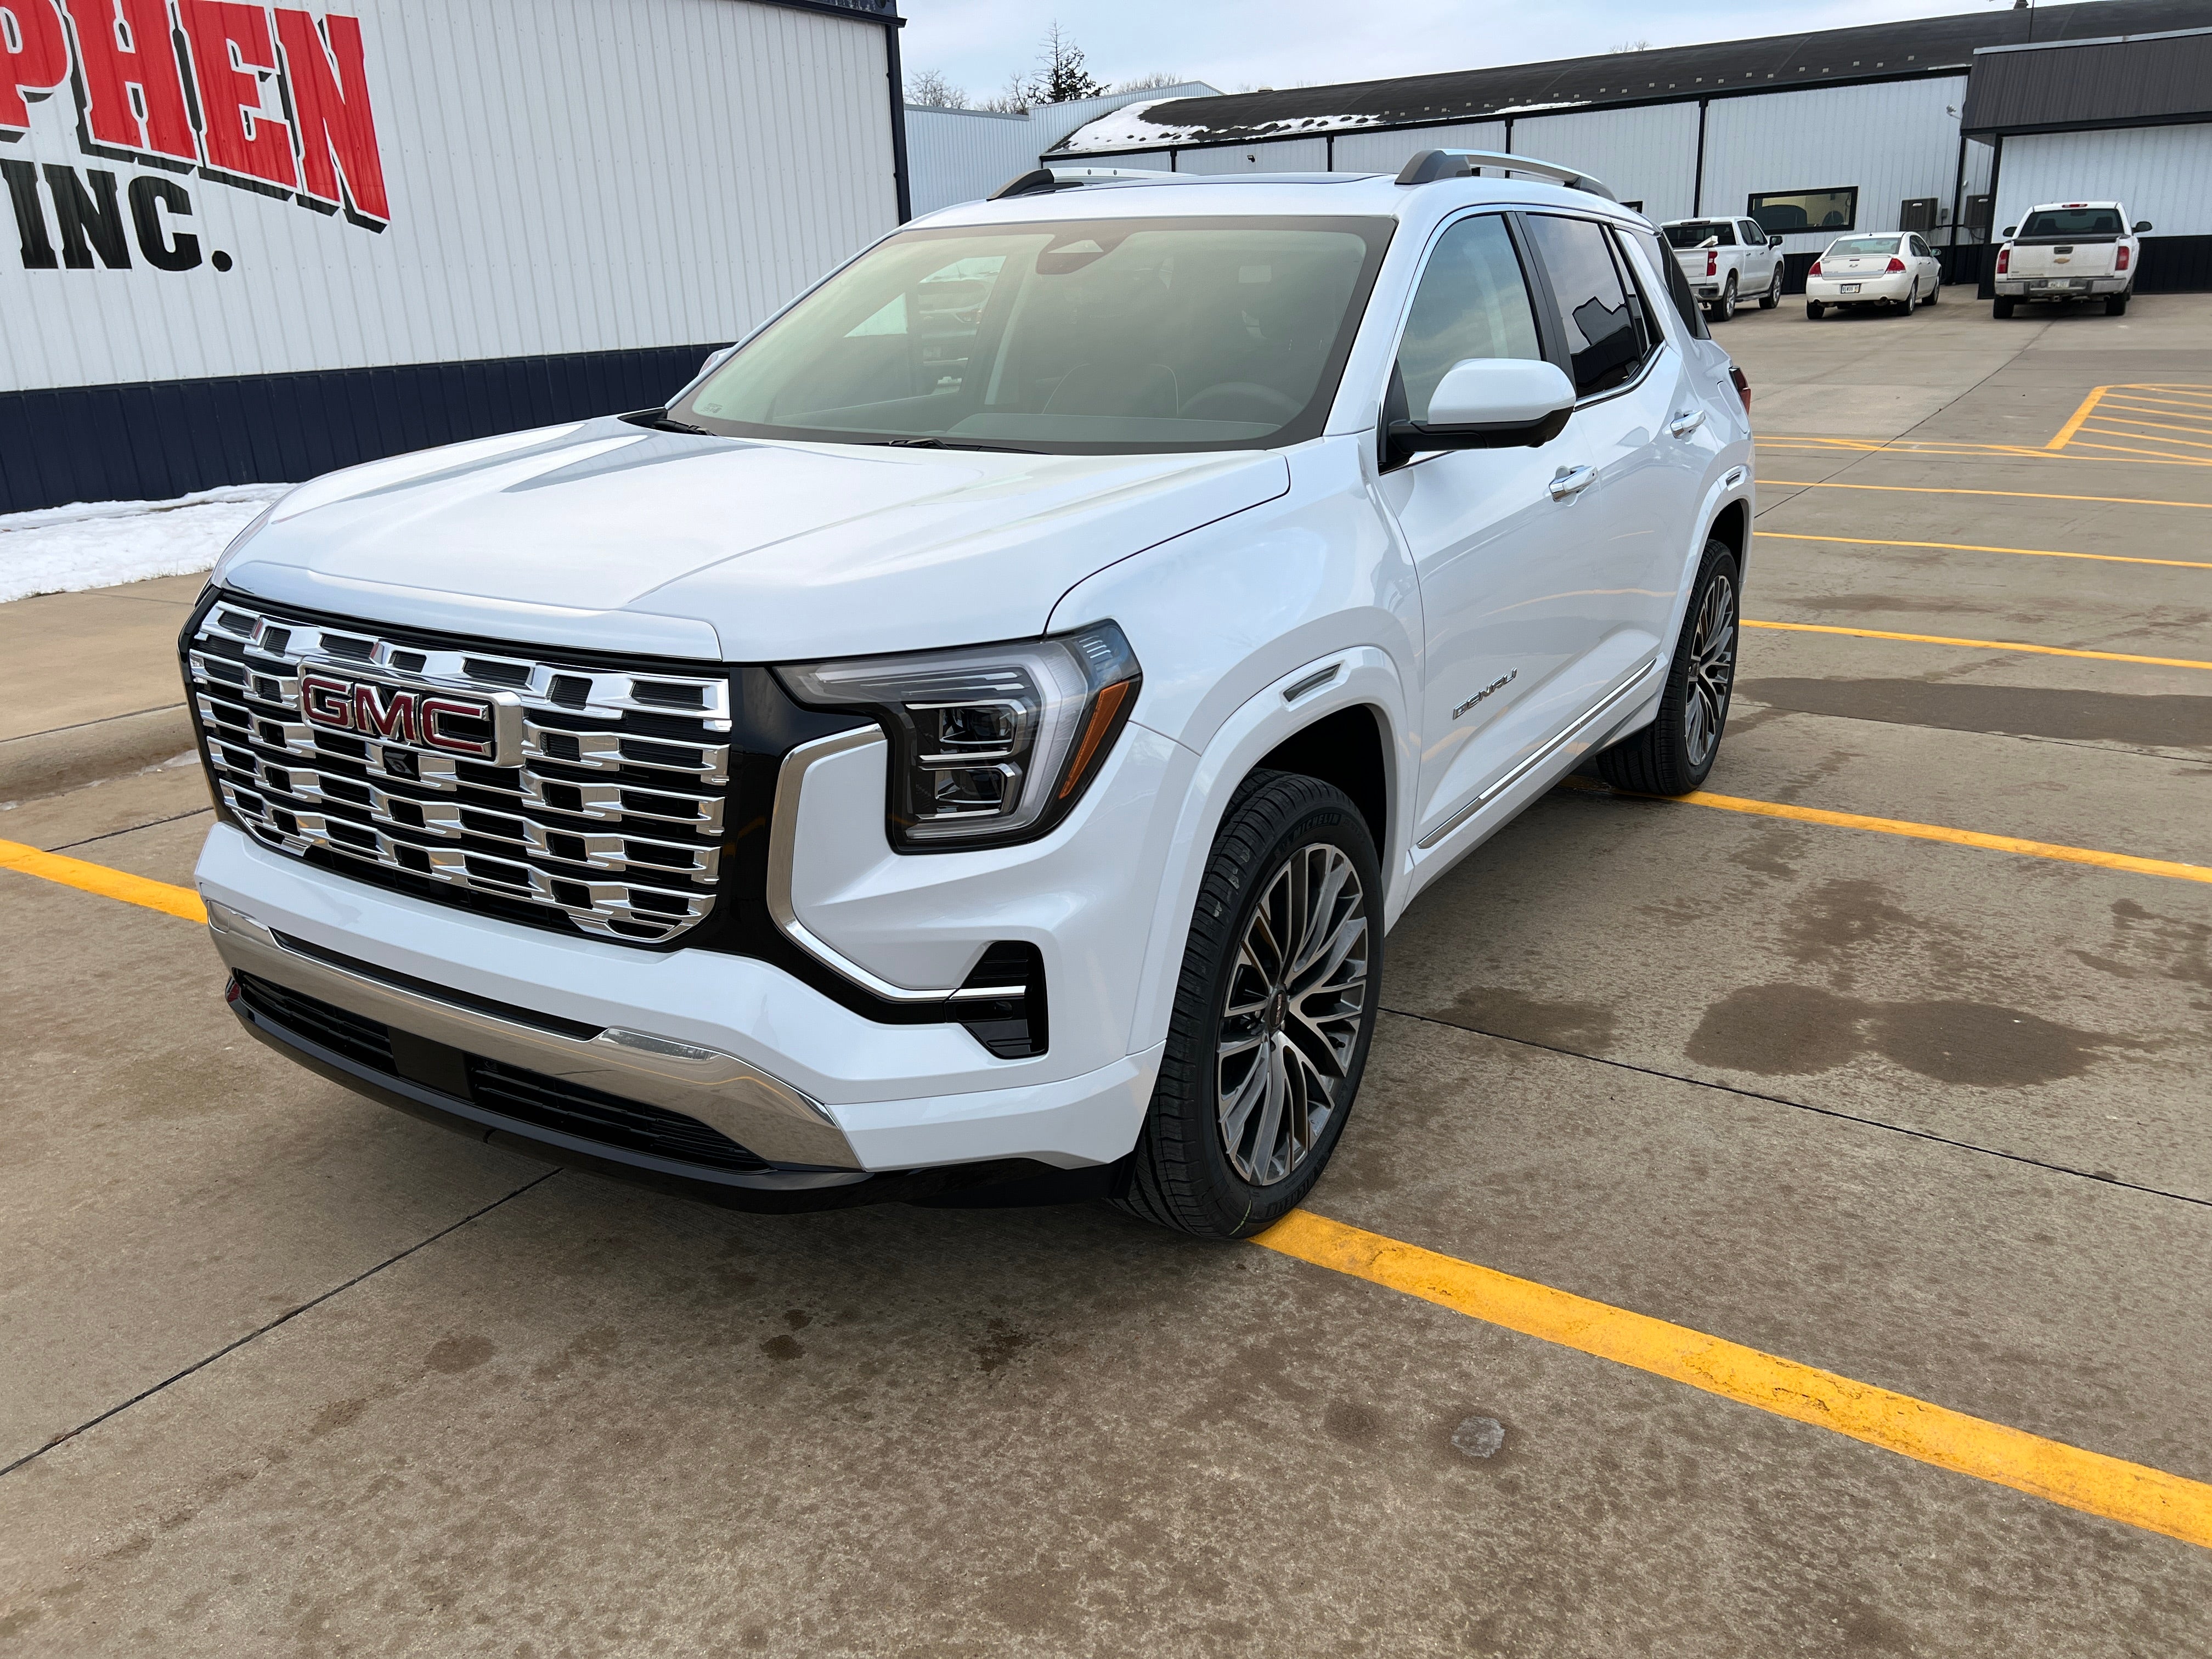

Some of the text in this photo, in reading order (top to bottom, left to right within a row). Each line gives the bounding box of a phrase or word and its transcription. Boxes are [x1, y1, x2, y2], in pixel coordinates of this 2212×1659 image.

[0, 0, 391, 233] PHEN
[1, 159, 233, 272] INC.
[302, 673, 493, 757] GMC
[1452, 667, 1518, 720] DENALI
[1293, 813, 1340, 839] MICHELIN
